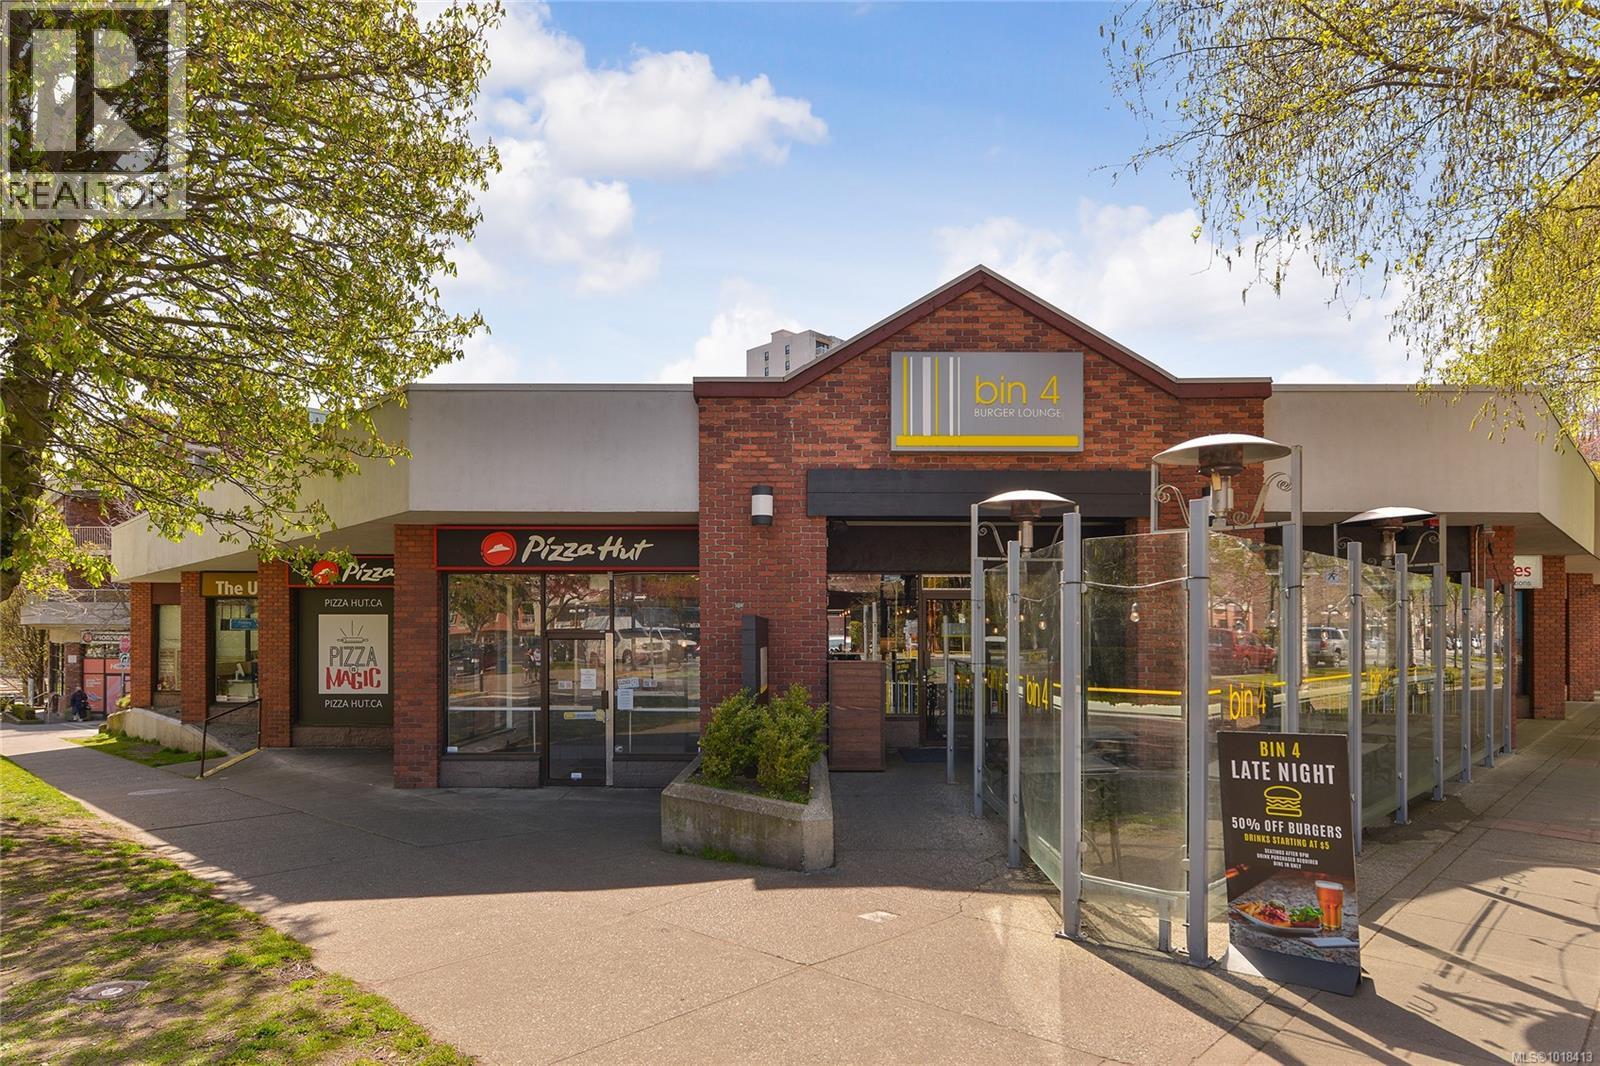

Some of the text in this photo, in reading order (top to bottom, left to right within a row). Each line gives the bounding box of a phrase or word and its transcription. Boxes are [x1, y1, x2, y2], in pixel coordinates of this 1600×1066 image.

[975, 375, 1060, 405] bin 4
[974, 408, 1061, 417] BURGER LOUNGE
[521, 535, 654, 563] Pizza Hut
[342, 563, 395, 582] Pizza
[216, 581, 243, 595] The
[324, 599, 382, 608] PIZZA HUT.CA
[329, 646, 378, 667] PIZZA
[326, 667, 381, 690] MAGIC
[1026, 674, 1041, 706] bin
[1042, 677, 1049, 710] 4
[1229, 680, 1266, 720] bin 4
[324, 700, 382, 708] PIZZA HUT.CA
[1260, 741, 1301, 758] BIN 4
[1231, 760, 1335, 785] LATE NIGHT
[1231, 816, 1342, 839] 50% OFF BURGERS
[1244, 833, 1330, 850] DRINKS STARTING AT $5
